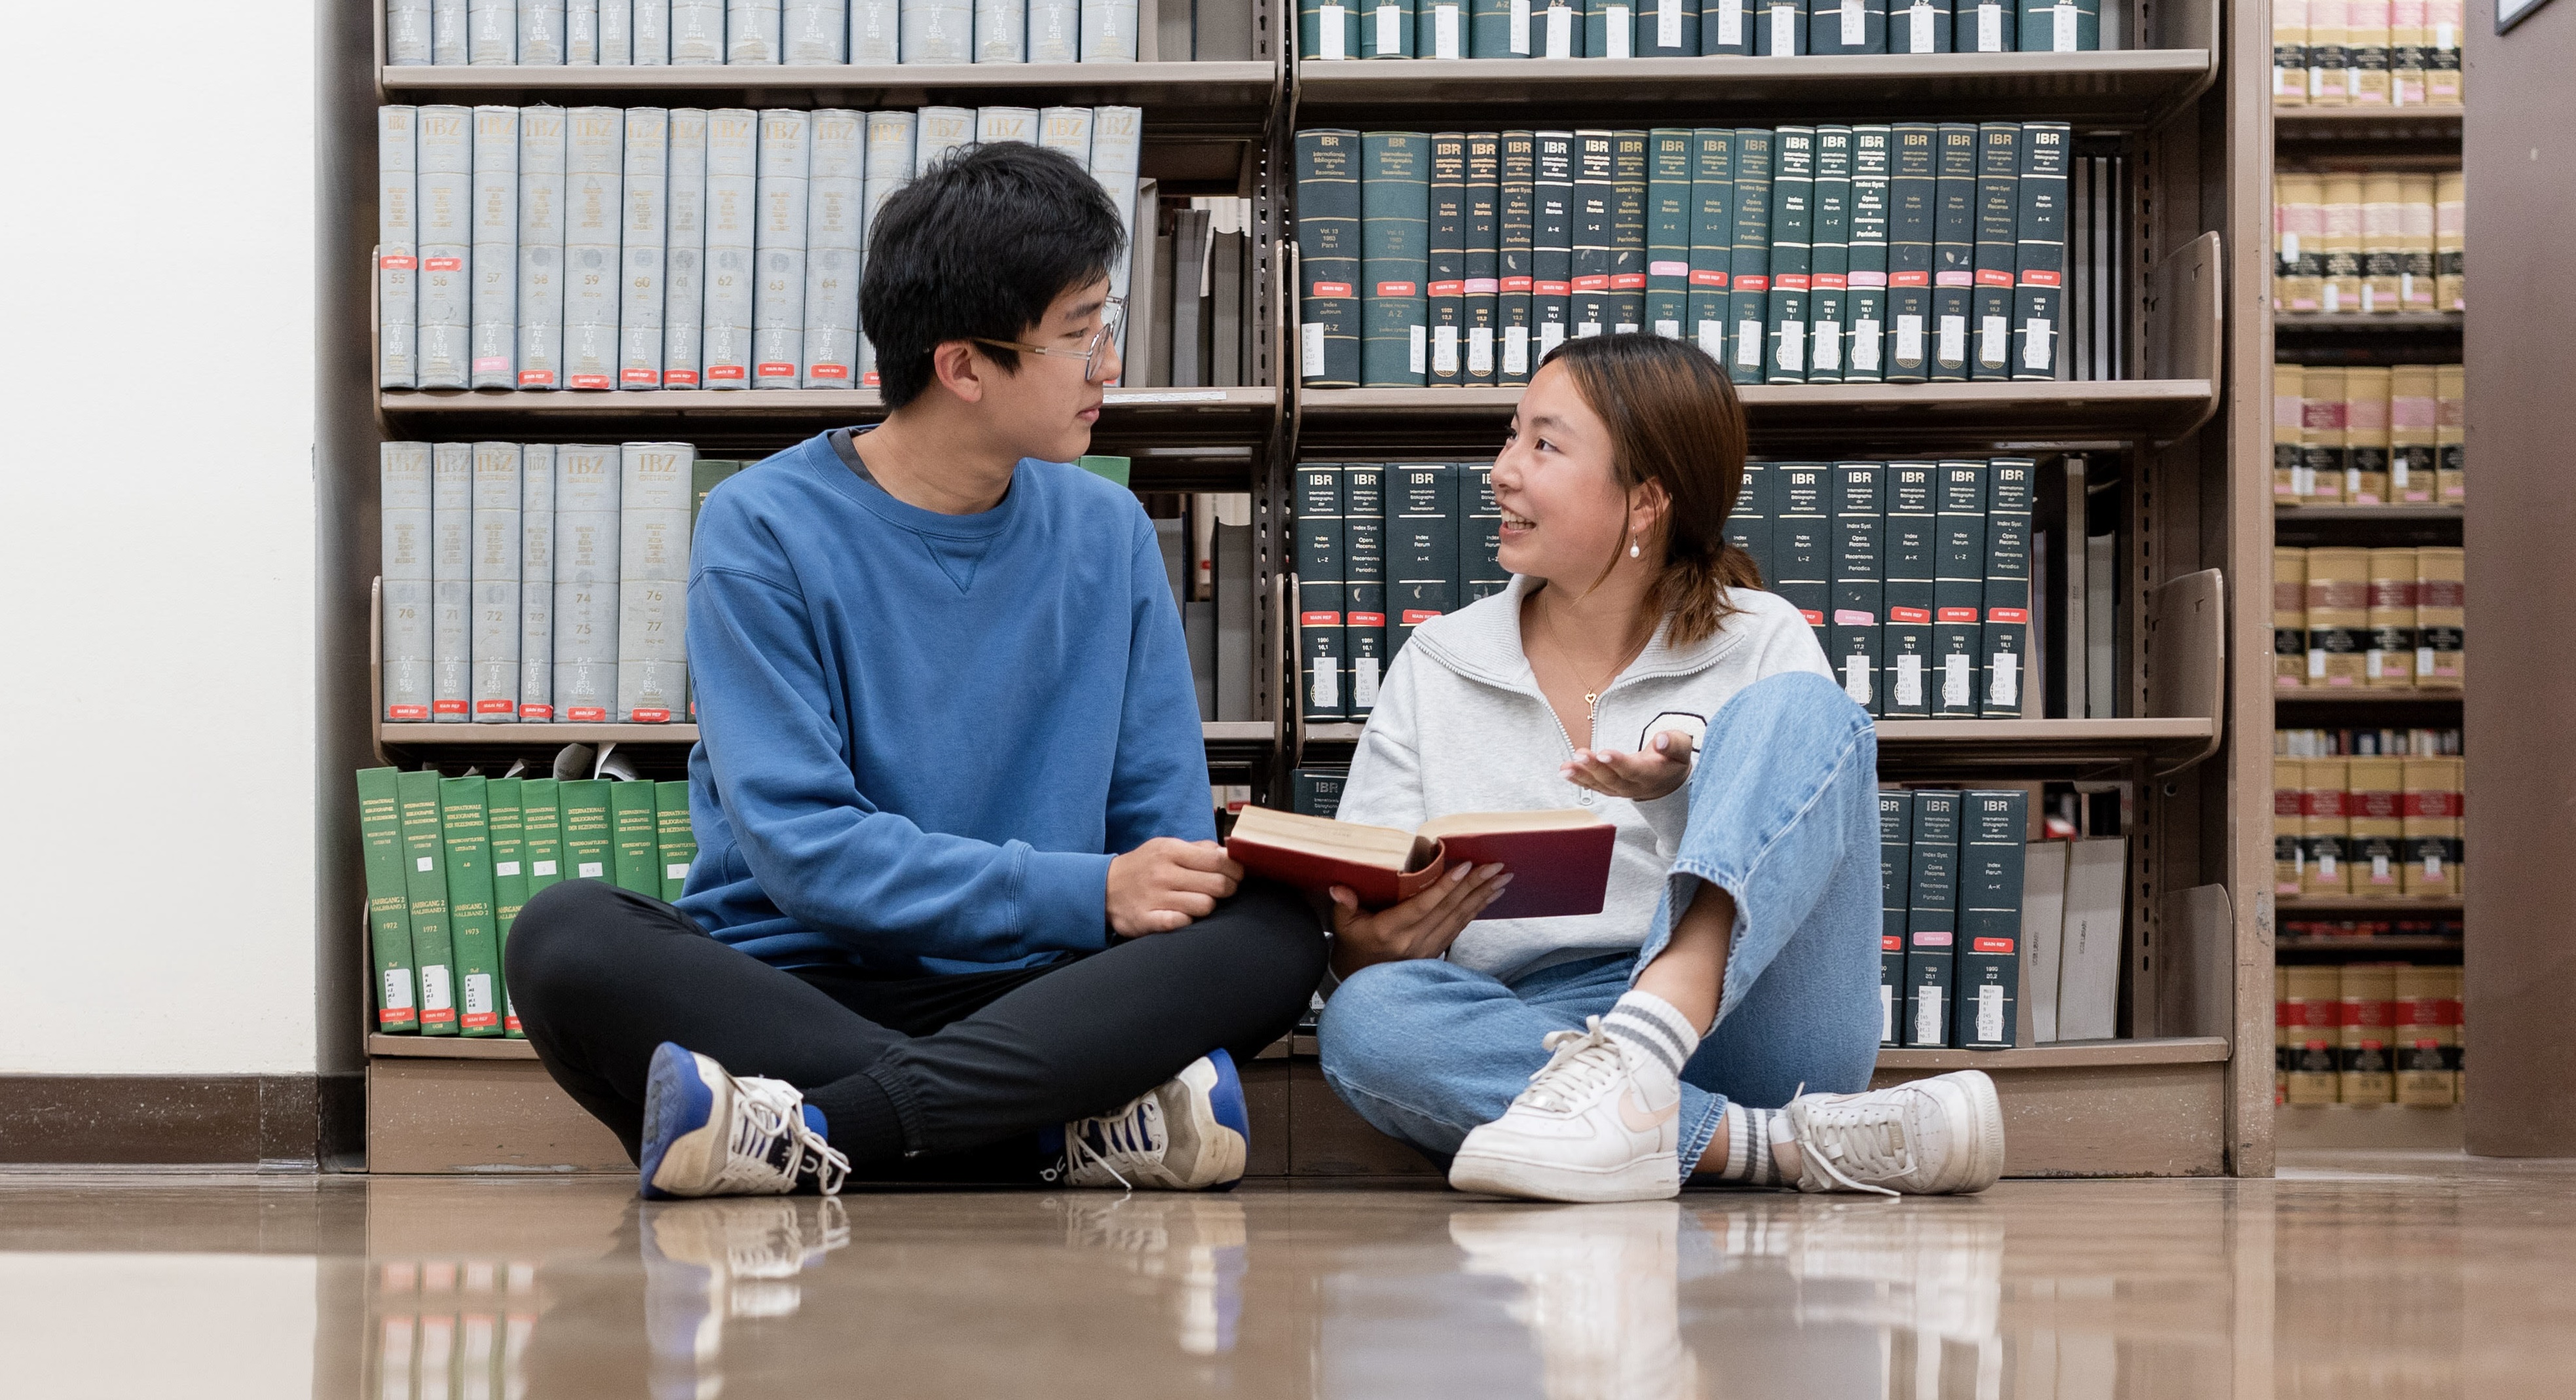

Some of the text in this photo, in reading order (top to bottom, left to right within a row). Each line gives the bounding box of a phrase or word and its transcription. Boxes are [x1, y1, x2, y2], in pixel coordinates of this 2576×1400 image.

[424, 118, 461, 136] IBZ
[479, 117, 515, 135] IBZ
[526, 119, 561, 137] IBZ
[576, 119, 612, 137] IBZ
[713, 121, 749, 138] IBZ
[765, 122, 802, 140] IBZ
[819, 122, 855, 140] IBZ
[927, 119, 963, 137] IBZ
[987, 119, 1024, 136] IBZ
[1048, 118, 1083, 137] IBZ
[870, 124, 906, 142] IBZ
[1321, 137, 1339, 146] IBR
[1389, 138, 1406, 147] IBR
[1785, 137, 1809, 149] IBR
[1823, 136, 1846, 148] IBR
[1860, 136, 1884, 148] IBR
[1904, 135, 1928, 145] IBR
[1947, 135, 1970, 146] IBR
[1989, 134, 2012, 145] IBR
[2036, 133, 2059, 145] IBR
[1437, 144, 1461, 155] IBR
[1472, 143, 1496, 155] IBR
[1508, 141, 1531, 153] IBR
[1544, 141, 1567, 154] IBR
[1586, 140, 1609, 153] IBR
[1620, 141, 1643, 153] IBR
[1661, 140, 1684, 152] IBR
[1704, 140, 1727, 152] IBR
[1745, 139, 1767, 151] IBR
[391, 274, 405, 284] 55
[433, 276, 447, 286] 56
[487, 272, 501, 283] 57
[533, 274, 548, 284] 58
[584, 275, 599, 285] 59
[634, 276, 650, 287] 60
[676, 277, 688, 287] 61
[718, 276, 733, 287] 62
[770, 280, 785, 291] 63
[822, 278, 837, 289] 64
[477, 454, 513, 472] IBZ
[568, 456, 605, 474] IBZ
[639, 454, 677, 472] IBZ
[1310, 474, 1333, 485] IBR
[1354, 474, 1377, 485] IBR
[1411, 473, 1434, 484] IBR
[1792, 473, 1815, 485] IBR
[1848, 472, 1871, 483] IBR
[1901, 471, 1925, 483] IBR
[1951, 471, 1975, 482] IBR
[2000, 470, 2024, 481] IBR
[576, 594, 591, 603] 74
[646, 591, 662, 600] 76
[399, 609, 415, 619] 70
[446, 610, 458, 619] 71
[487, 611, 502, 621] 72
[530, 613, 544, 621] 73
[576, 625, 591, 634] 75
[647, 622, 662, 631] 77
[1316, 782, 1338, 793] IBR
[1880, 800, 1899, 811] BR
[1926, 800, 1950, 812] IBR
[1984, 800, 2007, 811] IBR
